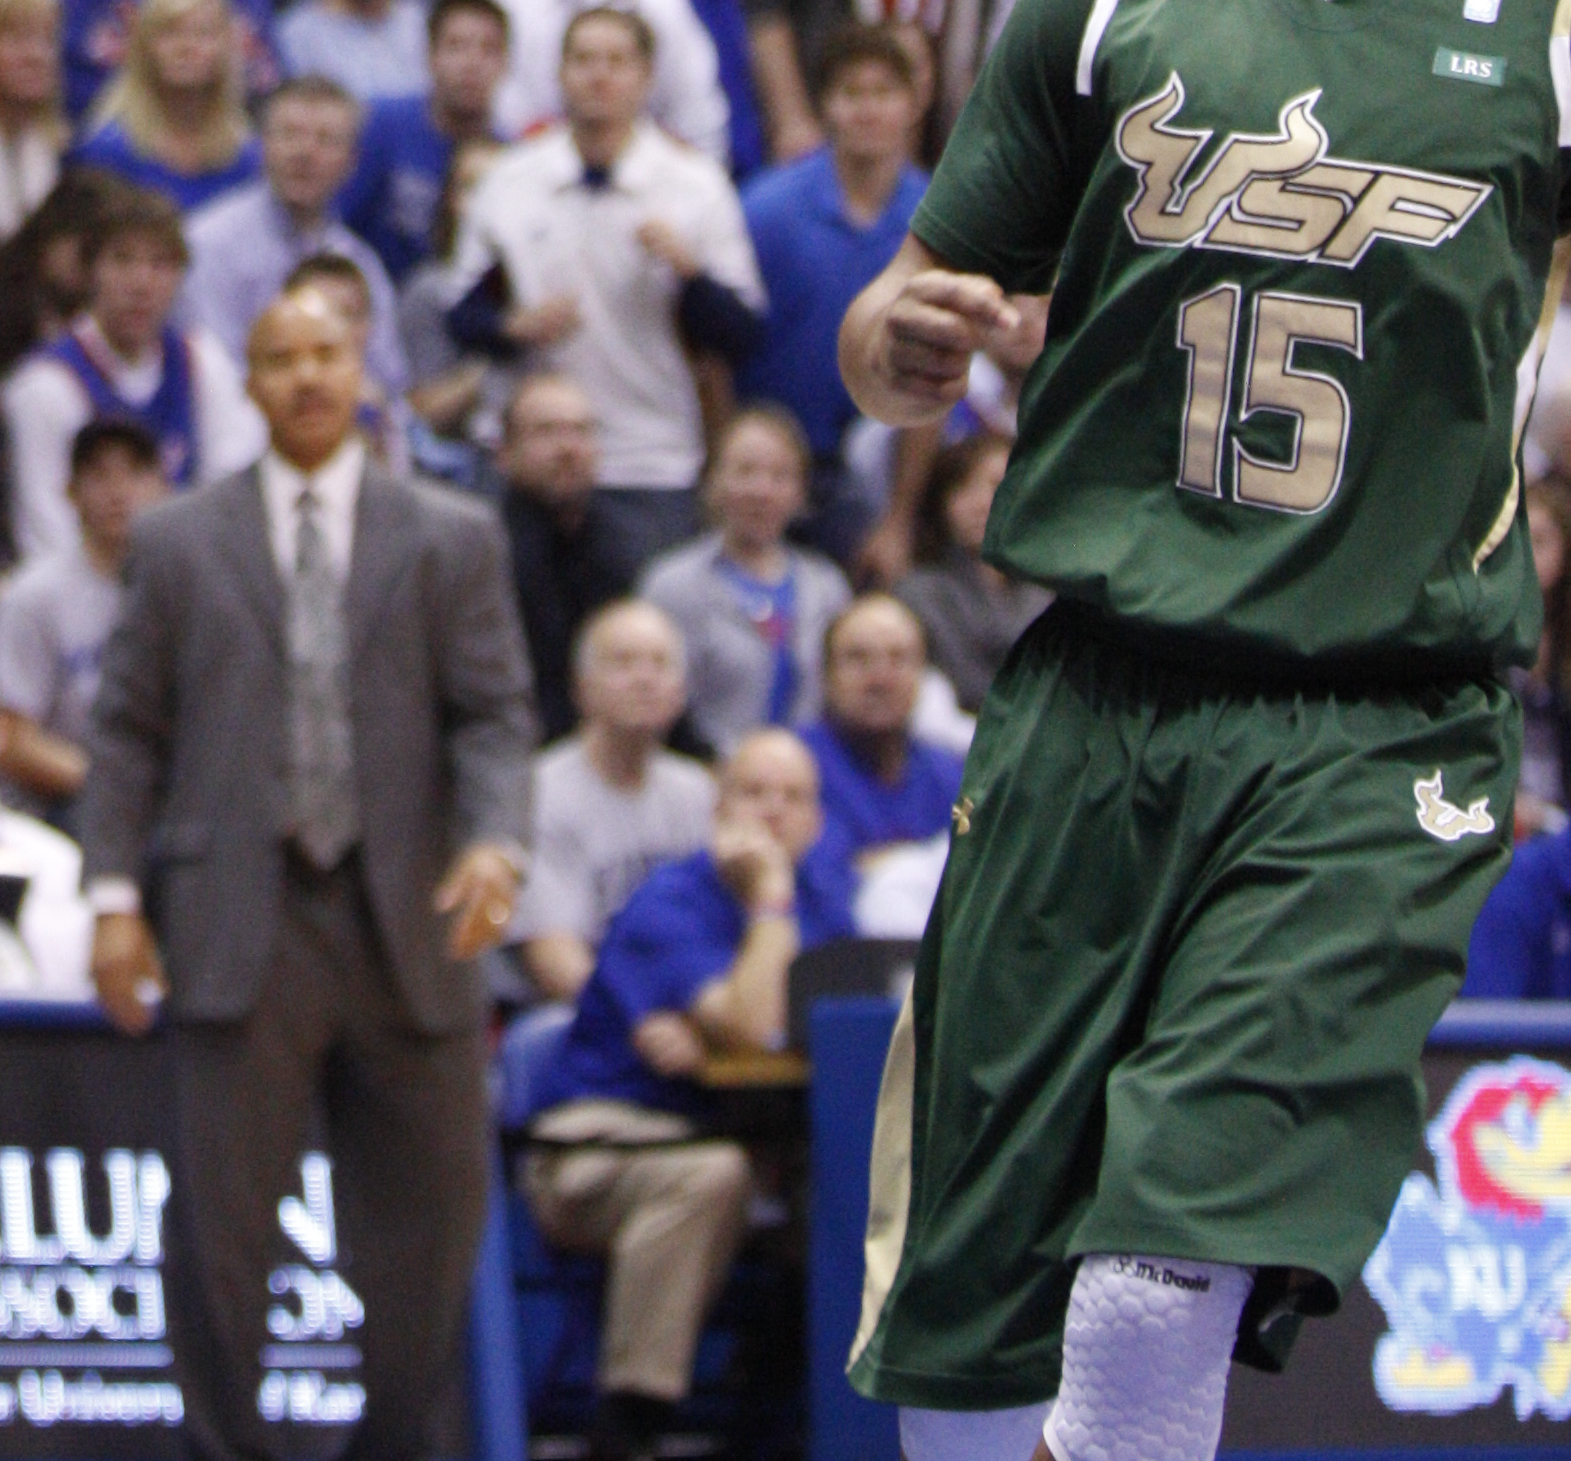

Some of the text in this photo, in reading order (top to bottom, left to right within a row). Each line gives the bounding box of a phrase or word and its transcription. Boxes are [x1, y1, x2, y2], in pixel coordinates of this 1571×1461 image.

[1450, 55, 1493, 78] LRS
[1115, 70, 1494, 270] USF
[1176, 281, 1364, 515] 15
